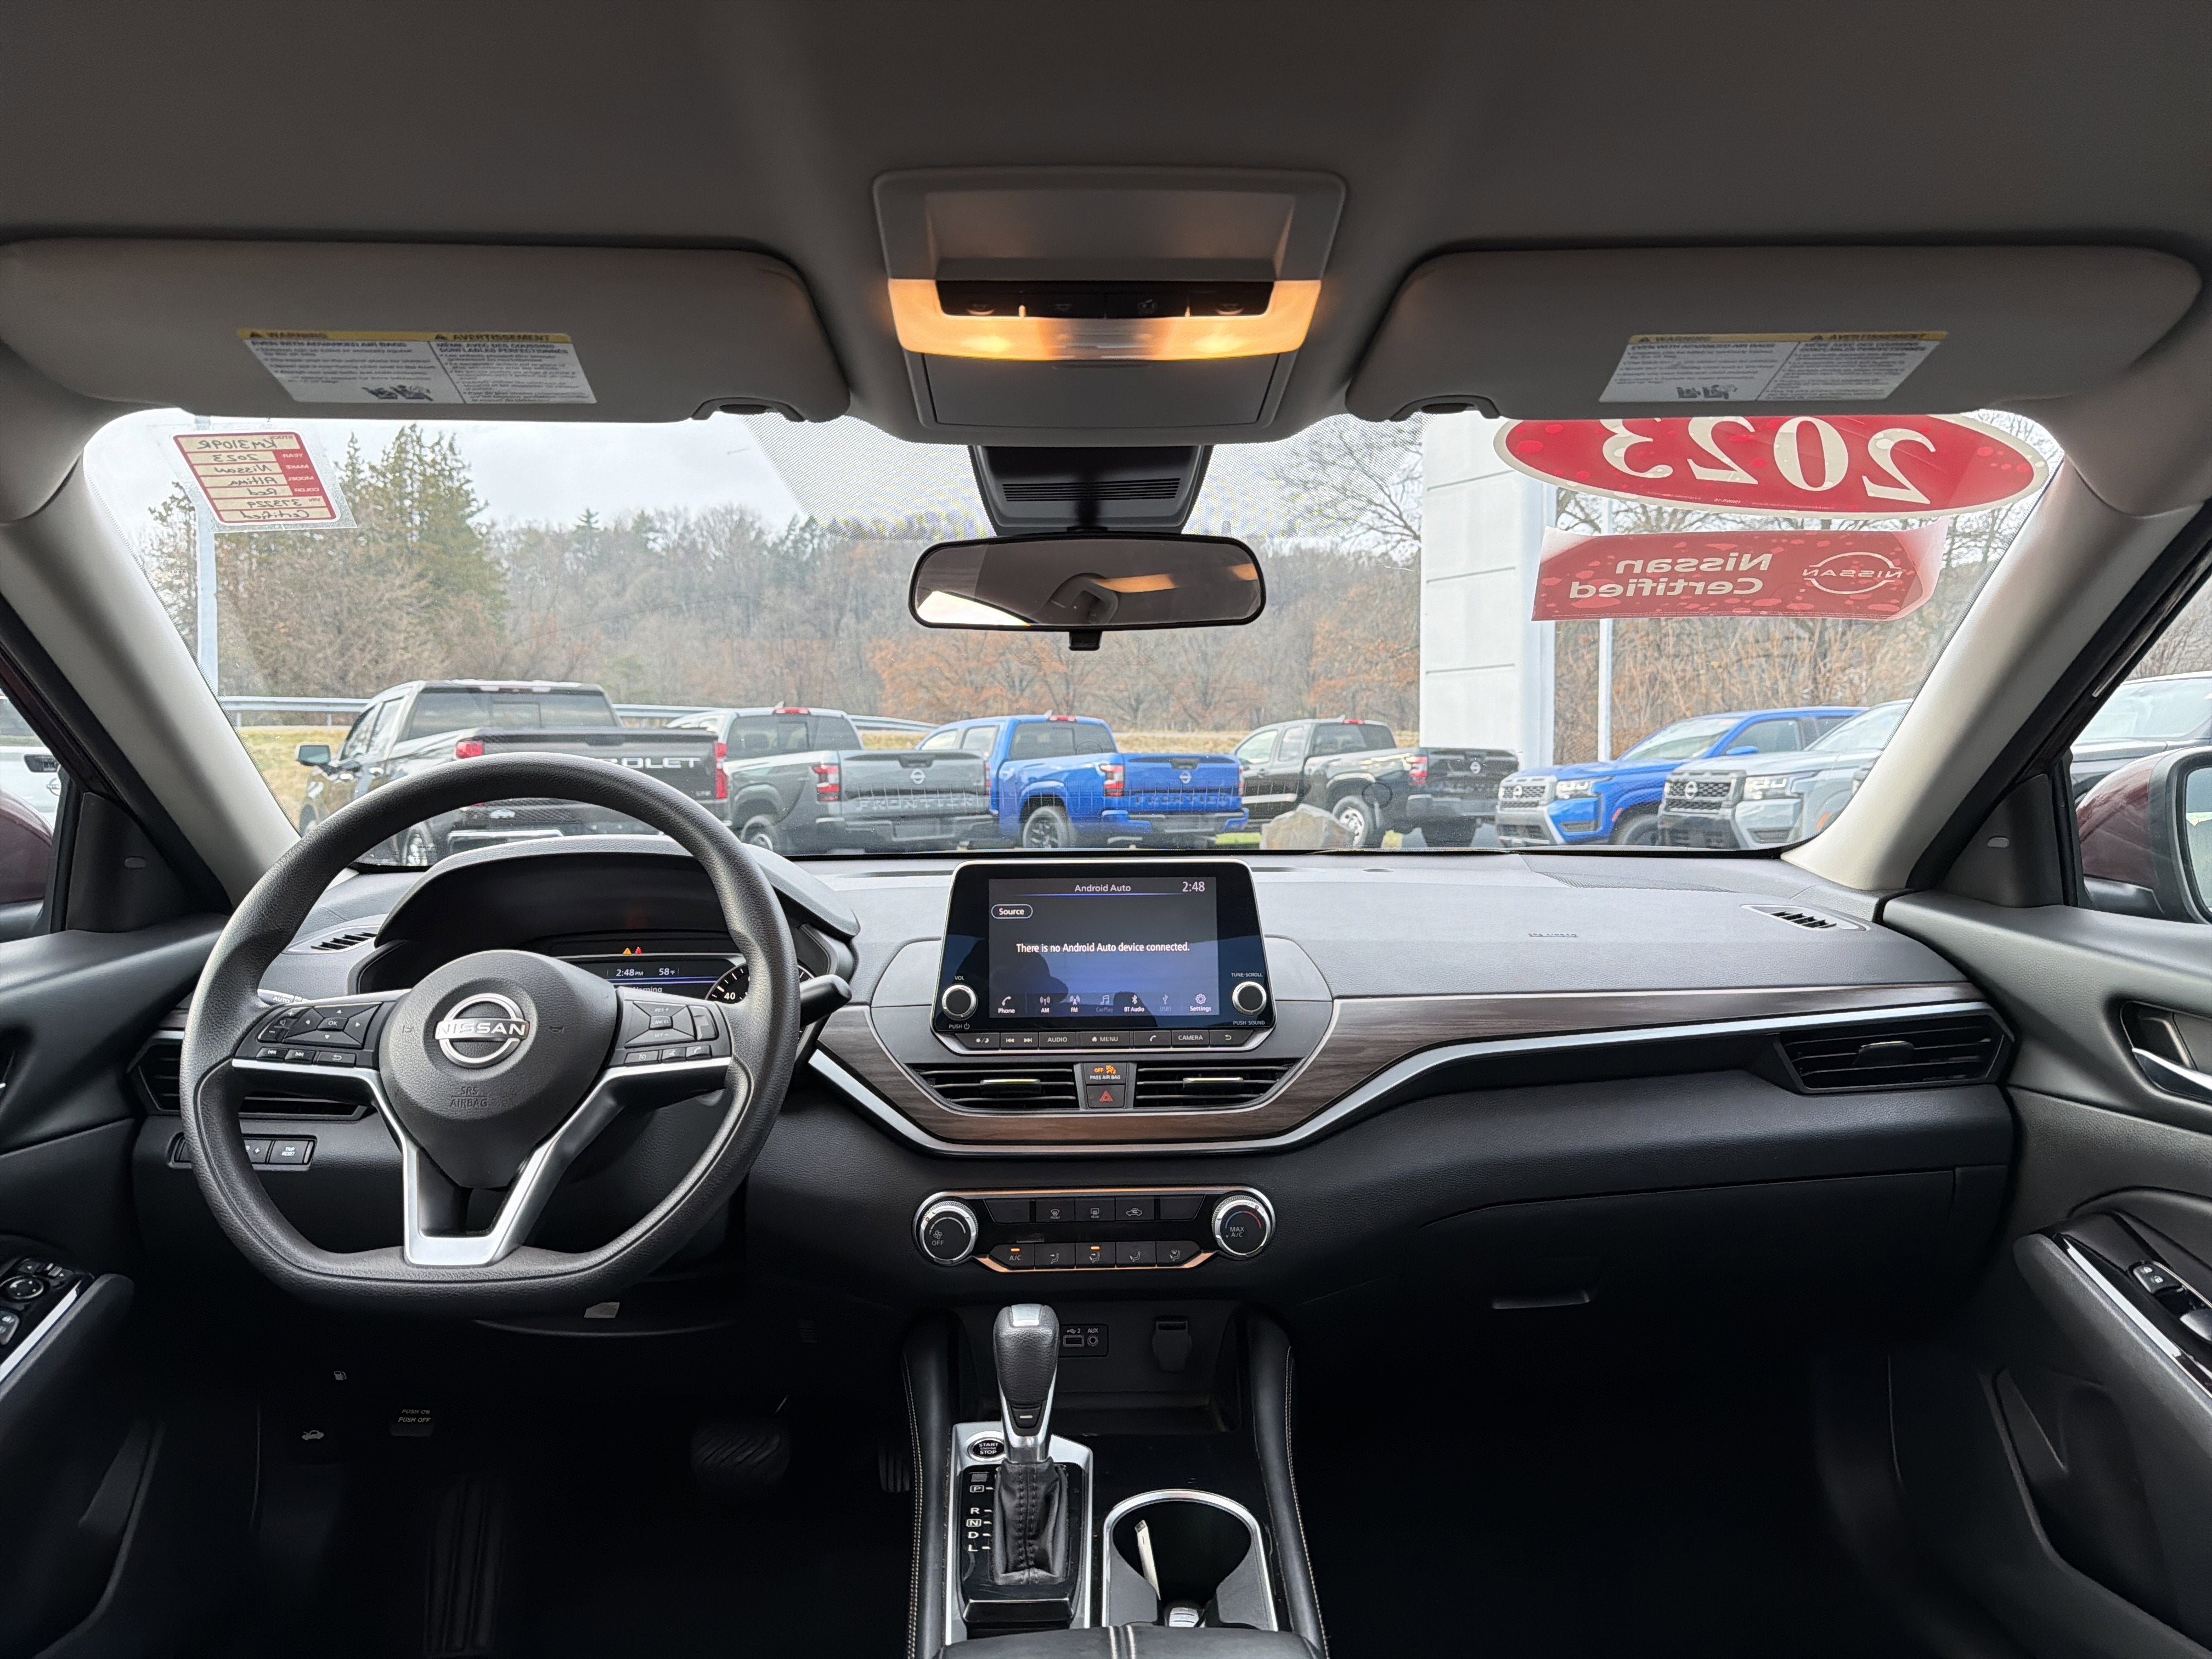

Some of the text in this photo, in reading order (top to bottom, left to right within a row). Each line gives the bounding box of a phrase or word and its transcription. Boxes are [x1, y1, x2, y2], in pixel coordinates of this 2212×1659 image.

[1074, 884, 1131, 892] Android Auto
[1182, 881, 1205, 893] 2:48
[998, 907, 1025, 916] Source
[1016, 943, 1040, 953] There
[1041, 943, 1048, 952] is
[1063, 943, 1095, 952] Android
[1097, 943, 1117, 952] Auto
[1118, 942, 1144, 952] device
[1146, 941, 1190, 951] connected.
[724, 992, 736, 1000] 40
[439, 1022, 526, 1036] NISSAN
[460, 1086, 479, 1096] SRS
[449, 1098, 488, 1108] AIRBAG
